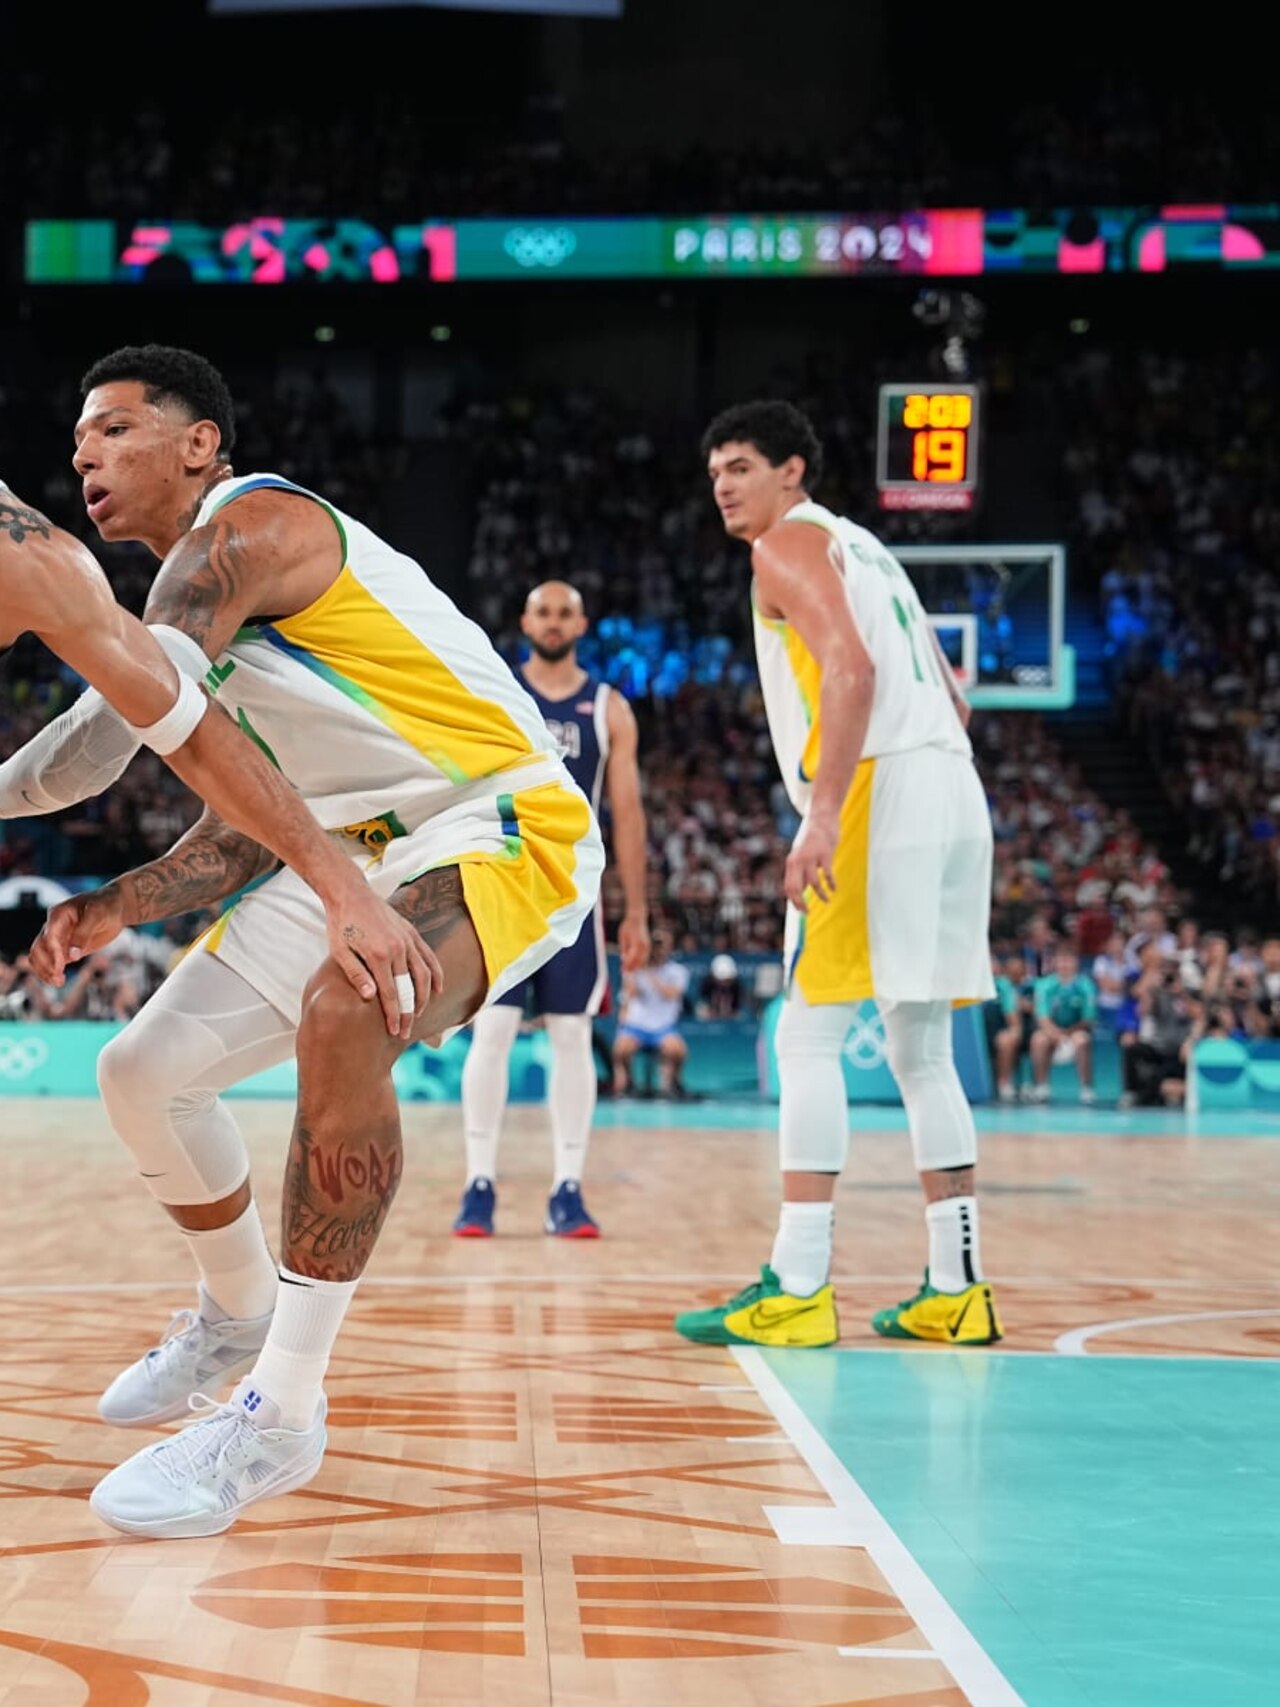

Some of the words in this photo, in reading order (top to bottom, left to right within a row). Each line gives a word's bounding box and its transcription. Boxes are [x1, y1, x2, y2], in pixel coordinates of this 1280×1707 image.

[674, 226, 802, 262] PARIS
[815, 225, 933, 261] 2024
[913, 430, 966, 483] 19
